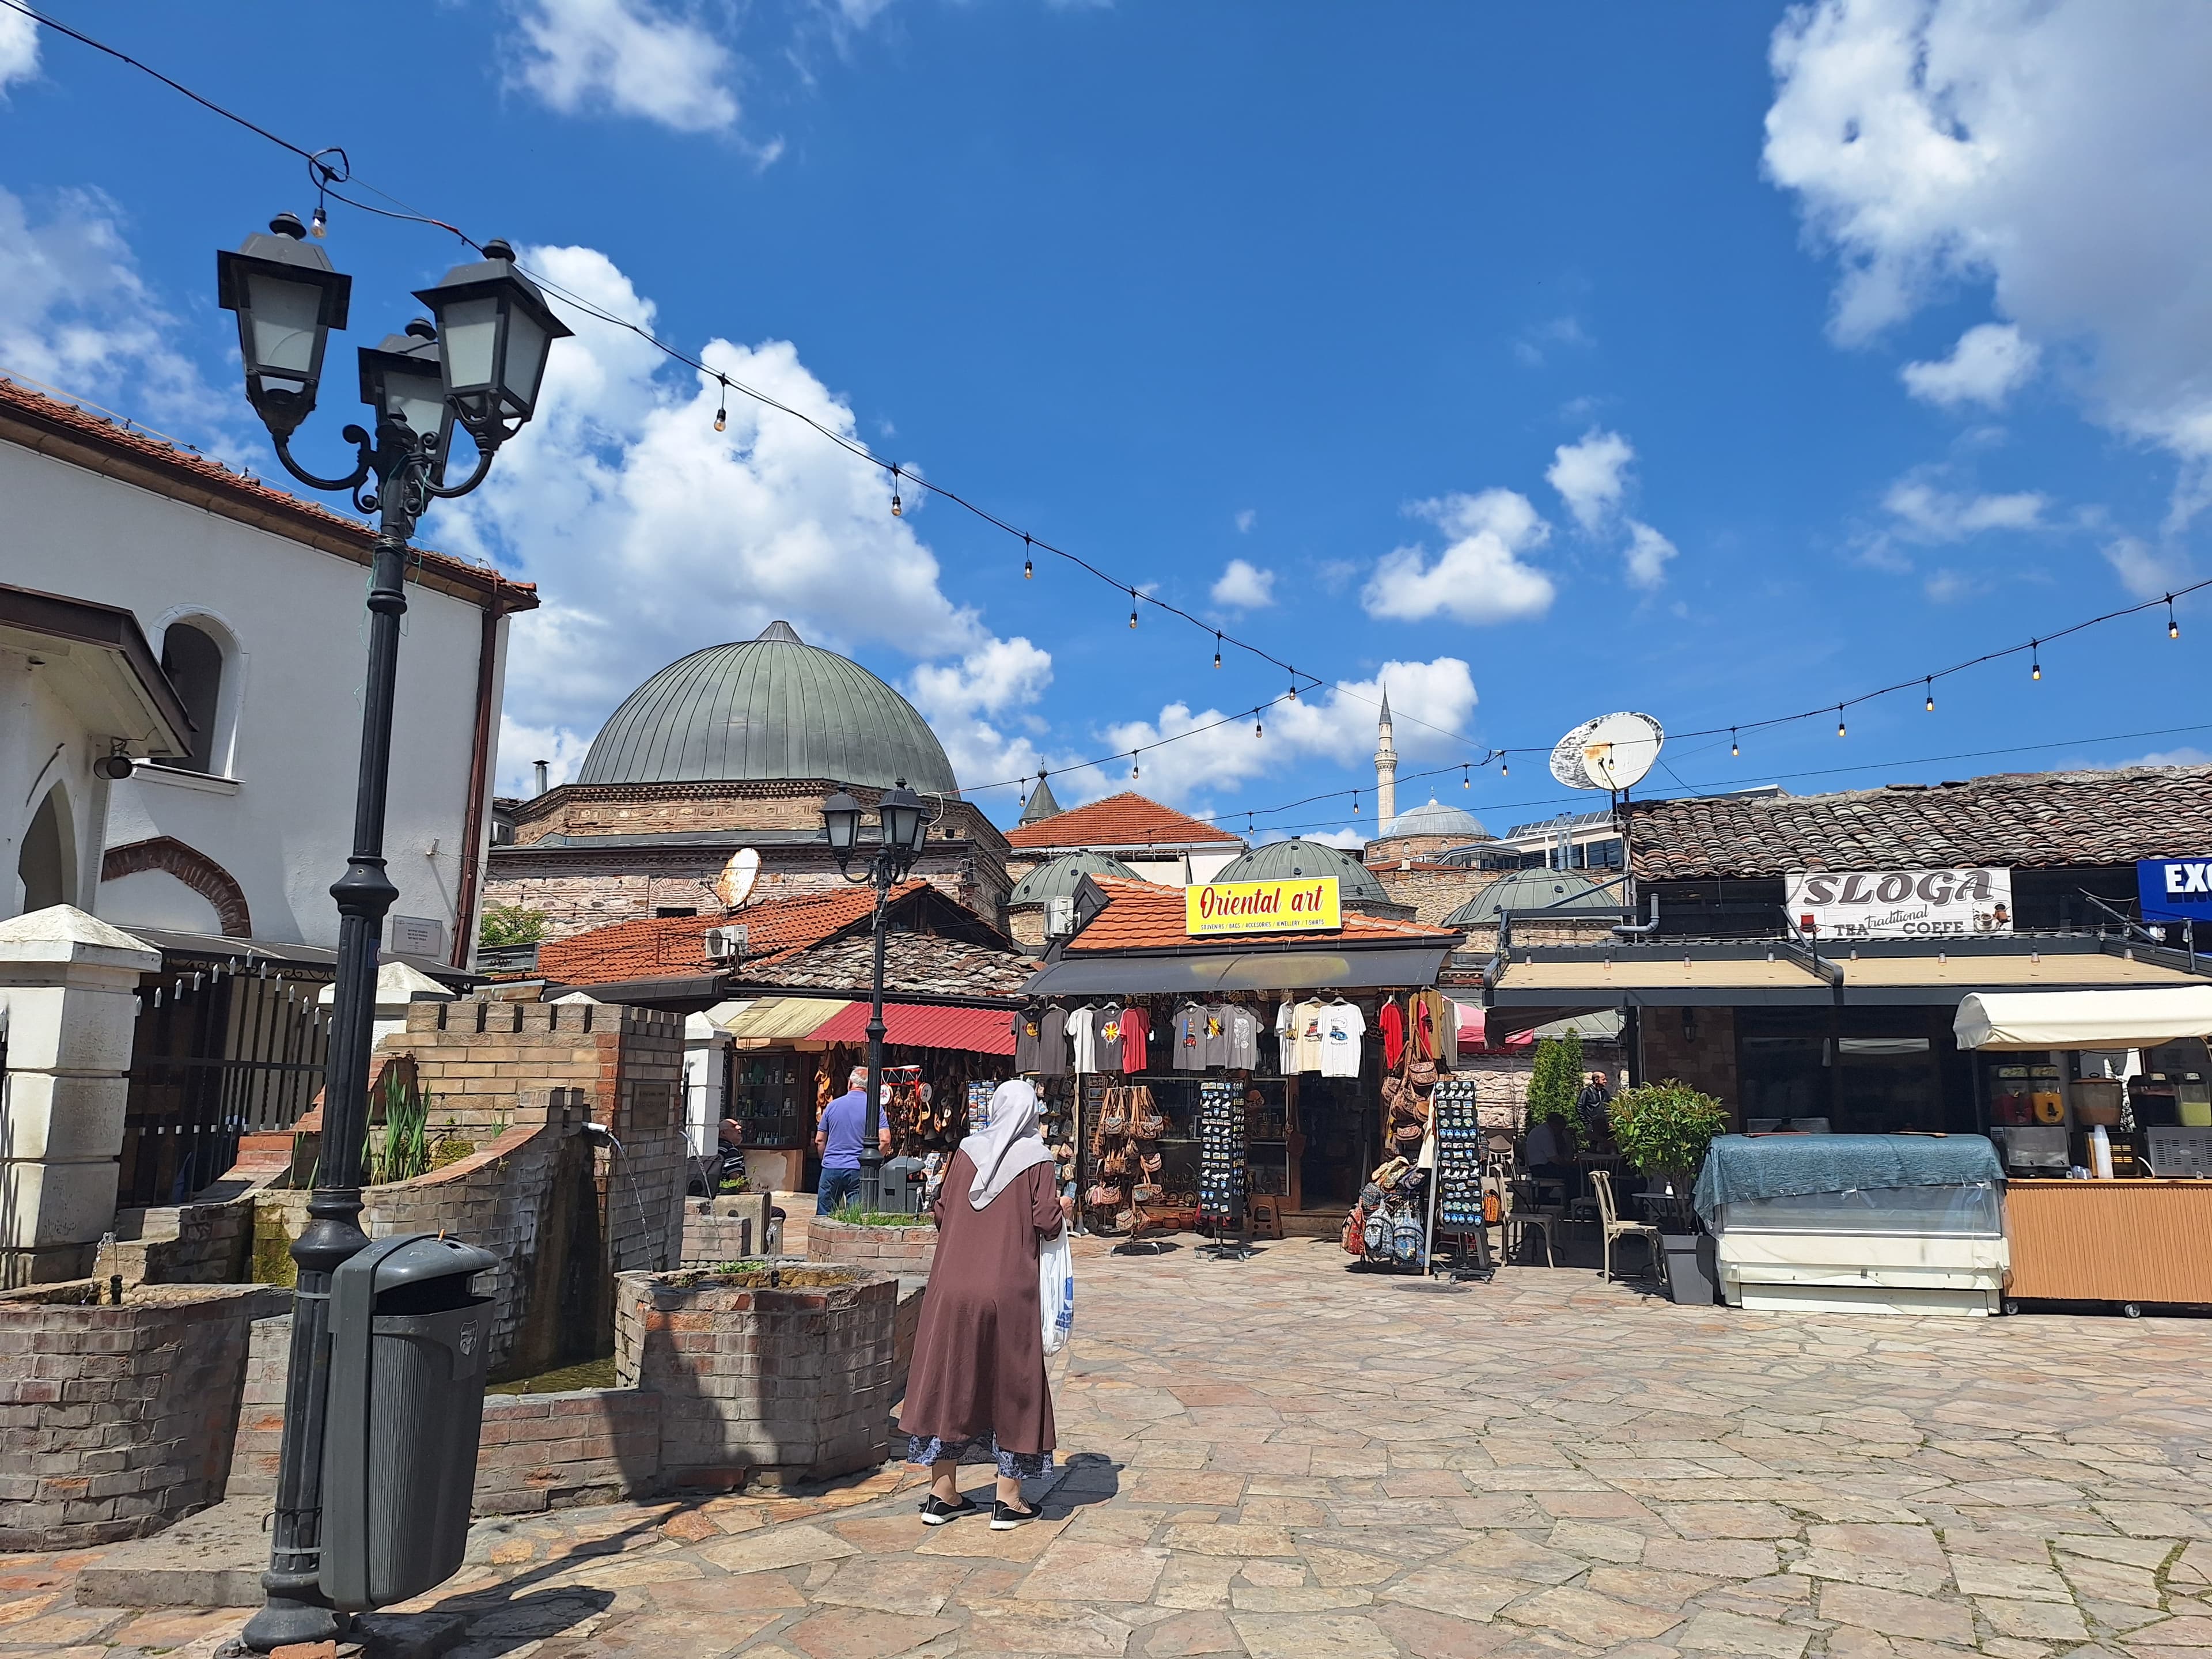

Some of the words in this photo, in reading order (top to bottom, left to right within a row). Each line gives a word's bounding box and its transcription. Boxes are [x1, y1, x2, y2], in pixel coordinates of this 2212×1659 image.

[1804, 869, 1994, 906] SLOGA
[2165, 863, 2212, 893] EX
[1200, 887, 1282, 919] Oriental
[1291, 885, 1323, 912] art
[1834, 924, 1870, 936] TEA
[1903, 921, 1964, 934] COFFE
